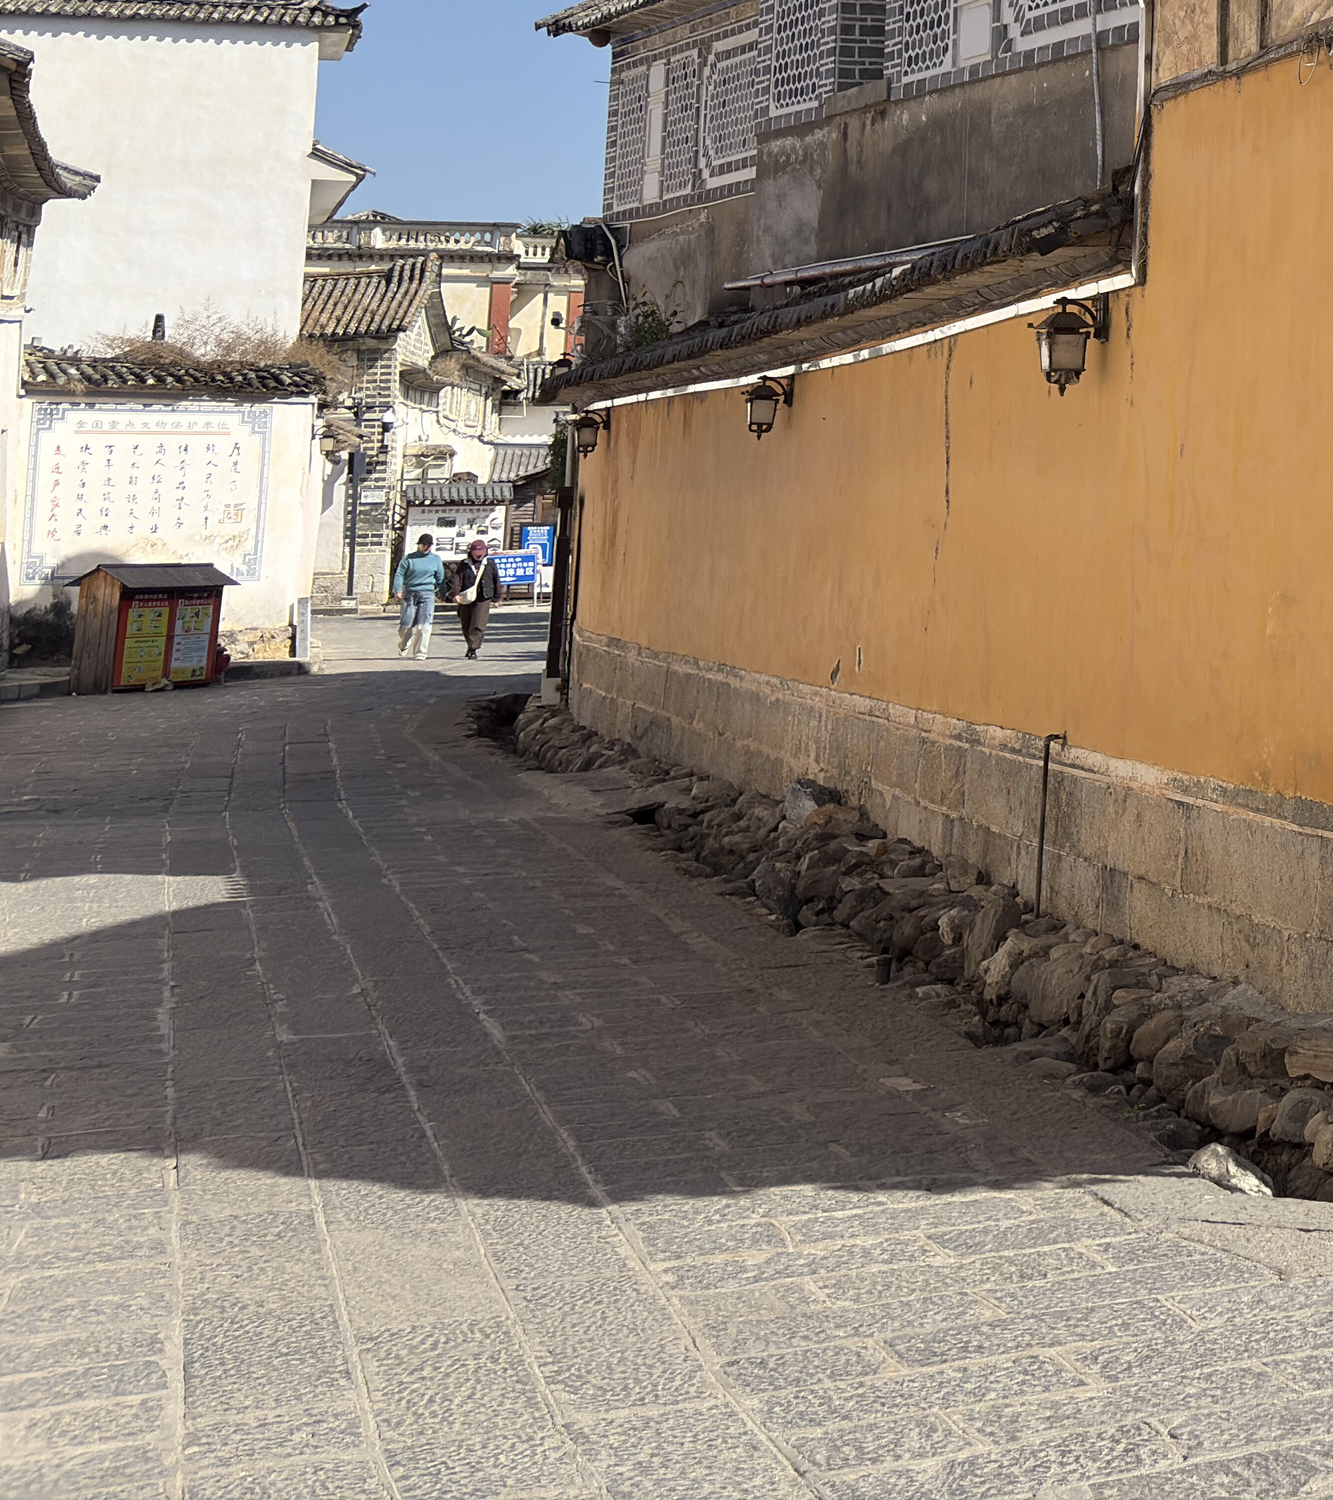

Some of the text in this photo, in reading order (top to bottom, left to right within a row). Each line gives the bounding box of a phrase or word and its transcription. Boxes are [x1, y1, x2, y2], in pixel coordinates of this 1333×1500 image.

[75, 419, 230, 430] 全国重点文物保护单位
